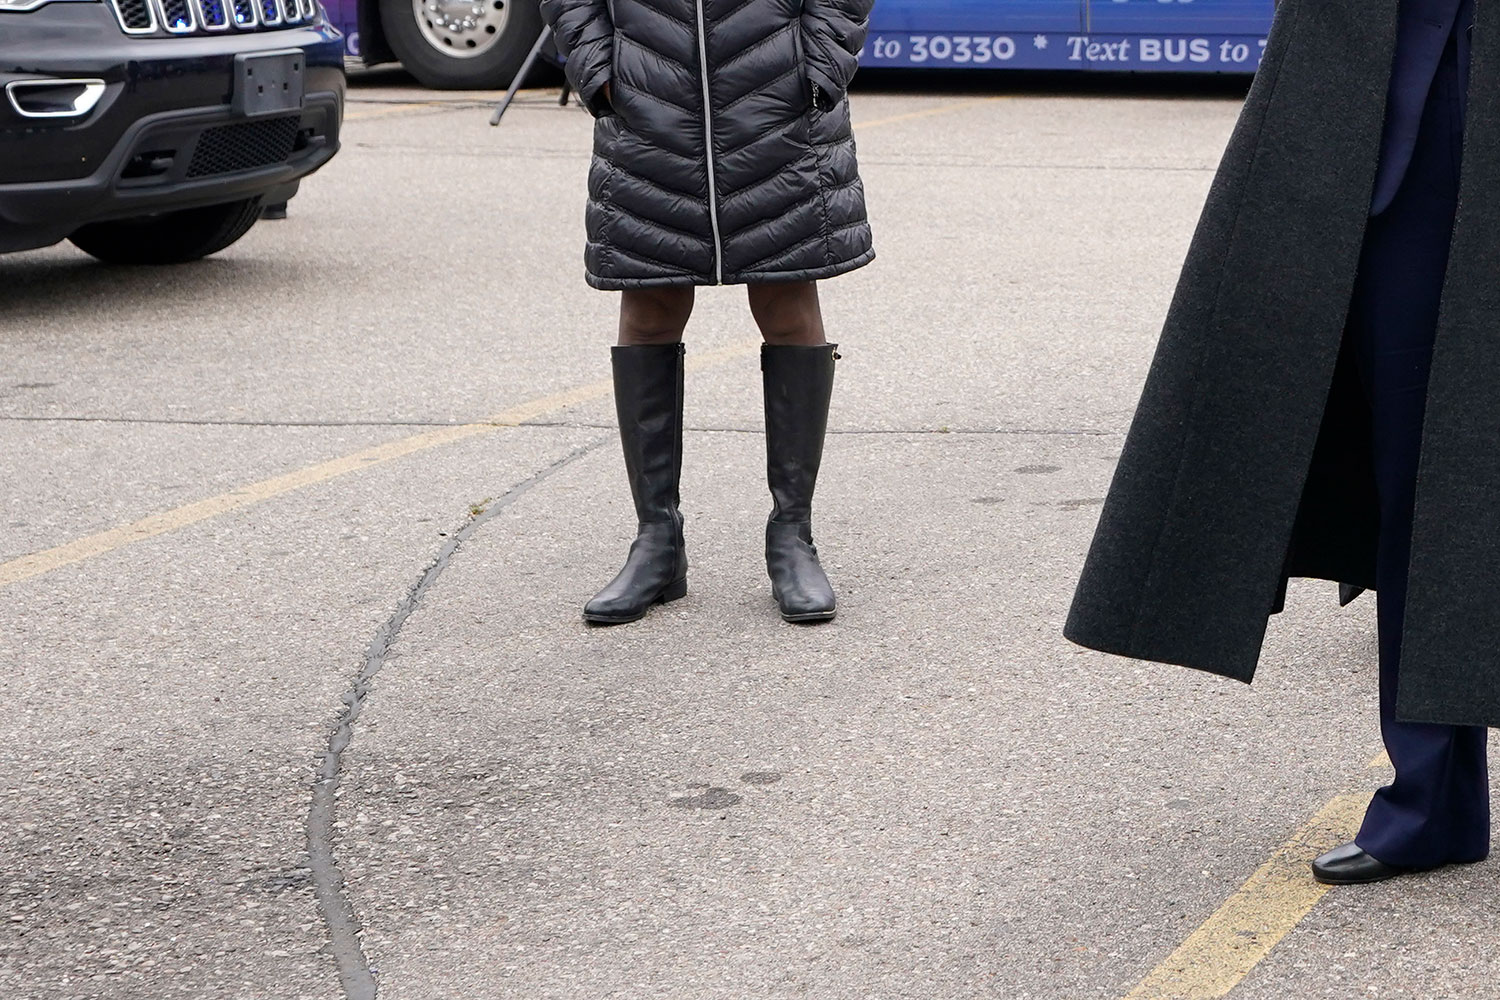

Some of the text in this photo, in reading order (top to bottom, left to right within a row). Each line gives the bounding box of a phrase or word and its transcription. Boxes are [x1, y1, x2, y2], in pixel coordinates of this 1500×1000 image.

[873, 36, 900, 59] to
[909, 35, 1016, 62] 30330
[1066, 36, 1130, 61] Text
[1139, 39, 1211, 62] BUS
[1218, 38, 1249, 64] to
